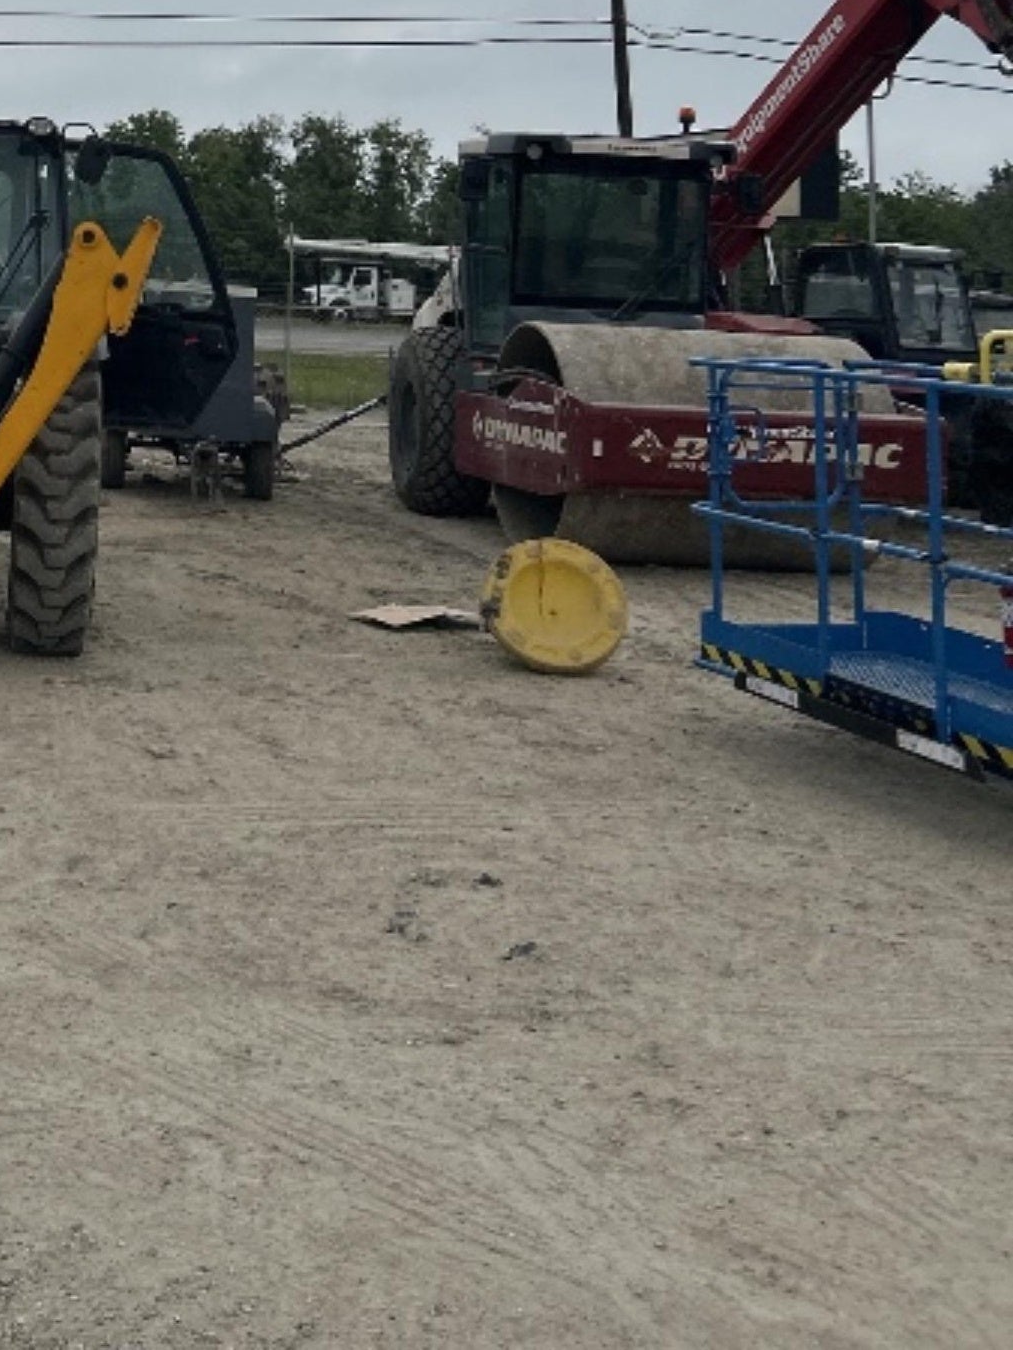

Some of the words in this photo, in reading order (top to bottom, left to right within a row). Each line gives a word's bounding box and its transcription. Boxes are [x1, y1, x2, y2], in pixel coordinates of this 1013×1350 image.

[737, 14, 846, 153] quipmentShare
[484, 416, 567, 455] DYNAPAC
[670, 436, 904, 469] DAPC
